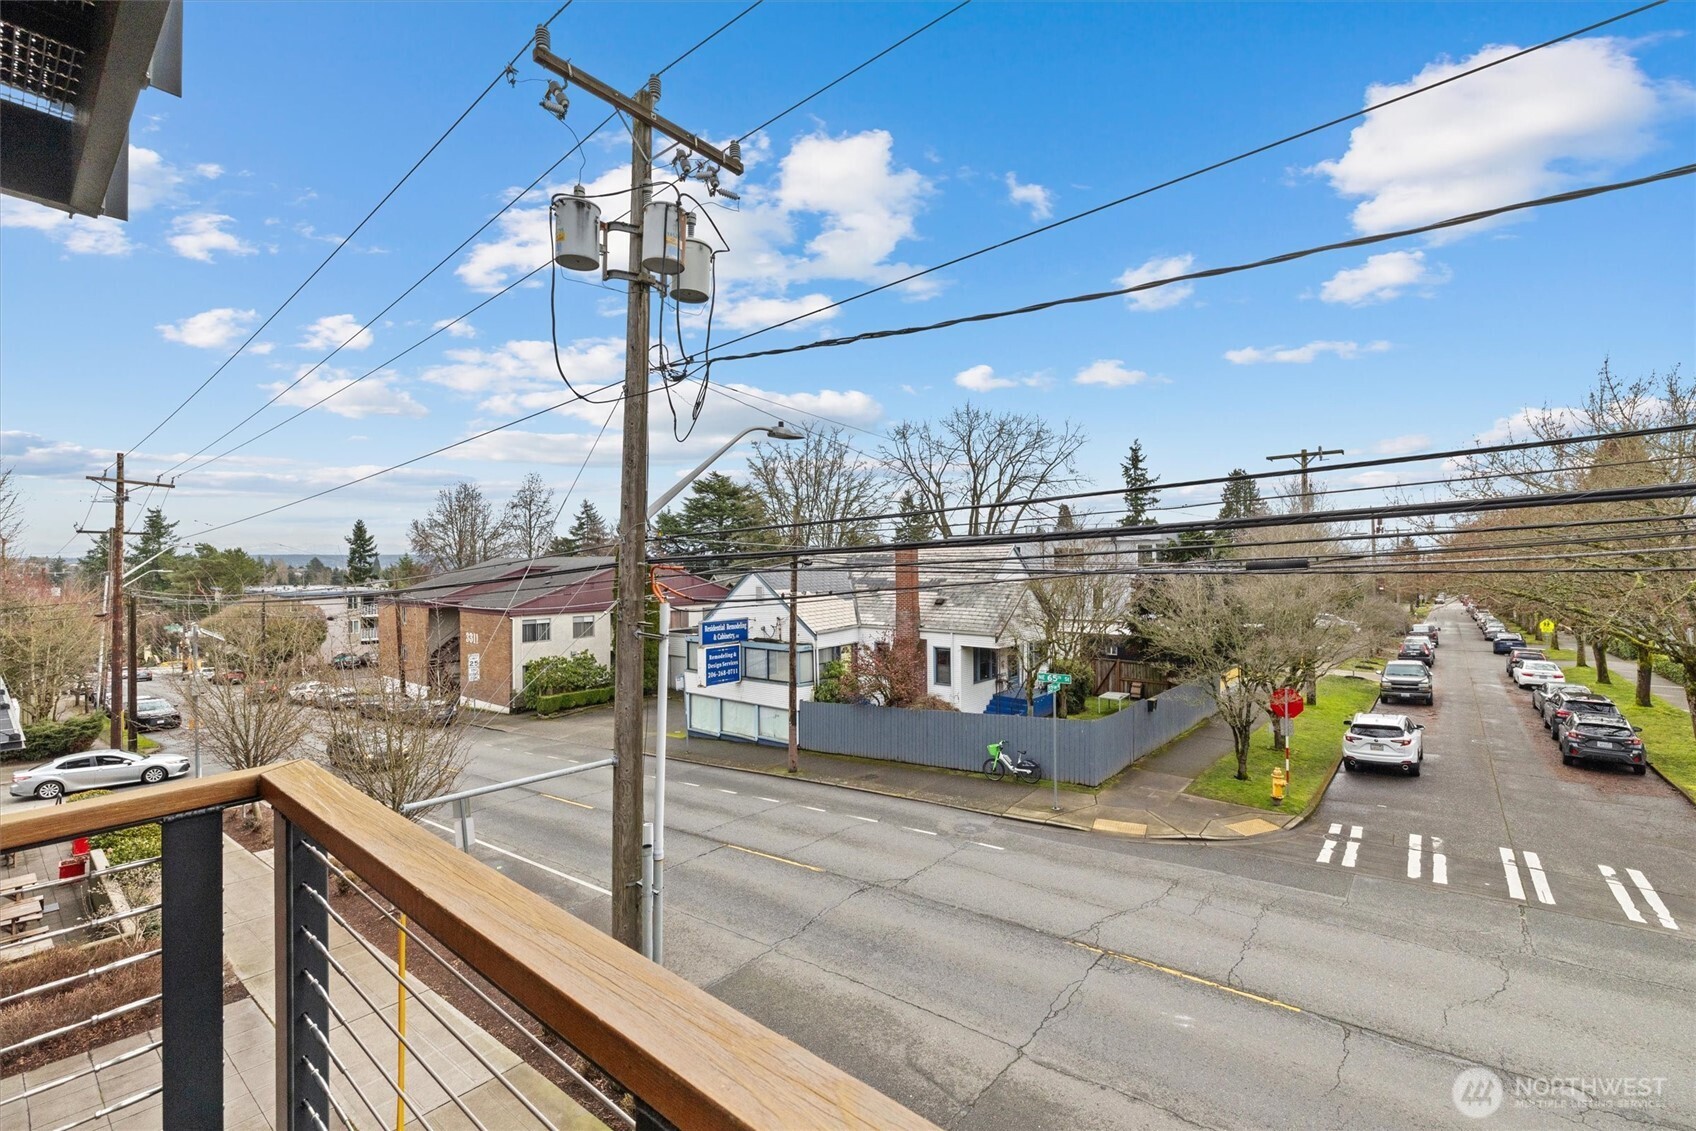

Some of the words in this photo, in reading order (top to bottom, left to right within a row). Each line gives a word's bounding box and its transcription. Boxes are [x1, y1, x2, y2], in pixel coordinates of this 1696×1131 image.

[704, 624, 725, 632] Residential
[726, 622, 747, 630] Remodeling
[709, 652, 733, 660] Remodeling
